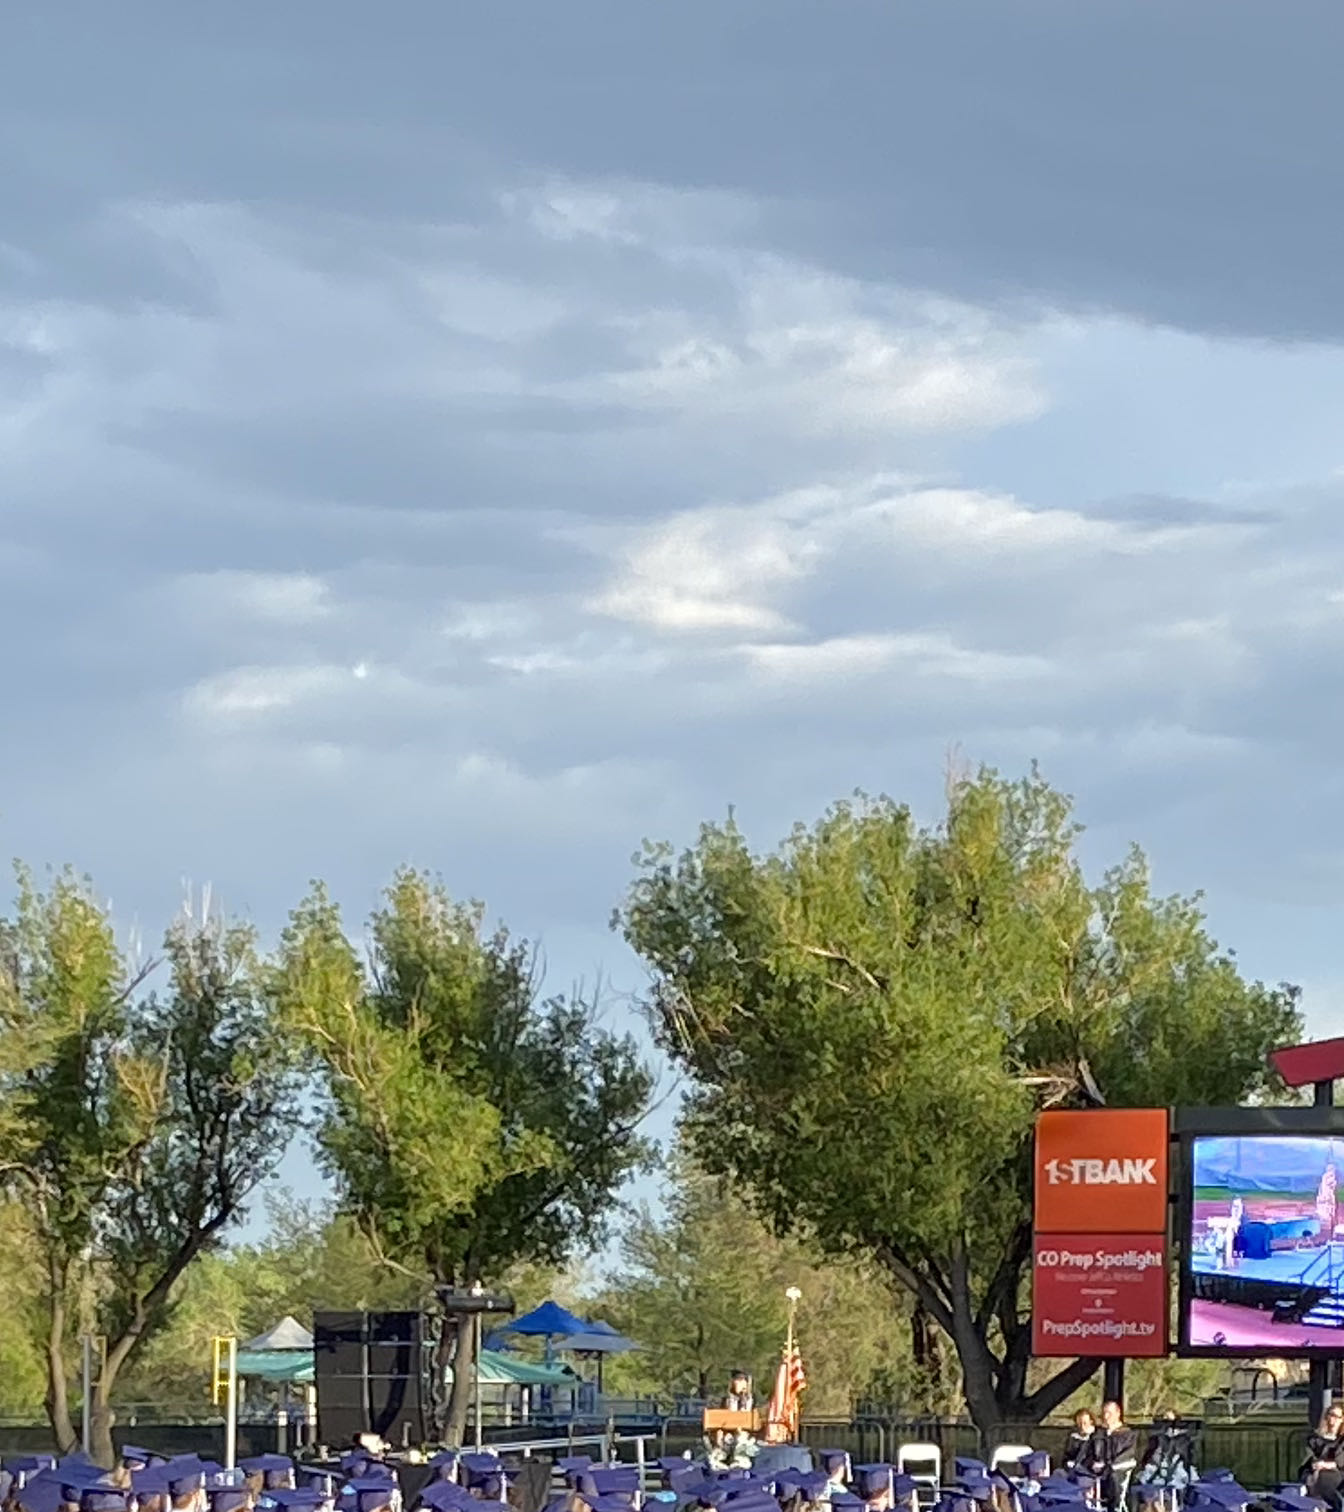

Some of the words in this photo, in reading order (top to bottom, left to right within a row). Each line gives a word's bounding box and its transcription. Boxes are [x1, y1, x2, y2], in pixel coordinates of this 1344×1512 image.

[1037, 1250, 1059, 1267] CO
[1060, 1250, 1094, 1271] Prep
[1095, 1250, 1163, 1271] Spotlight
[1041, 1318, 1156, 1340] PrepSpotlight.tv
